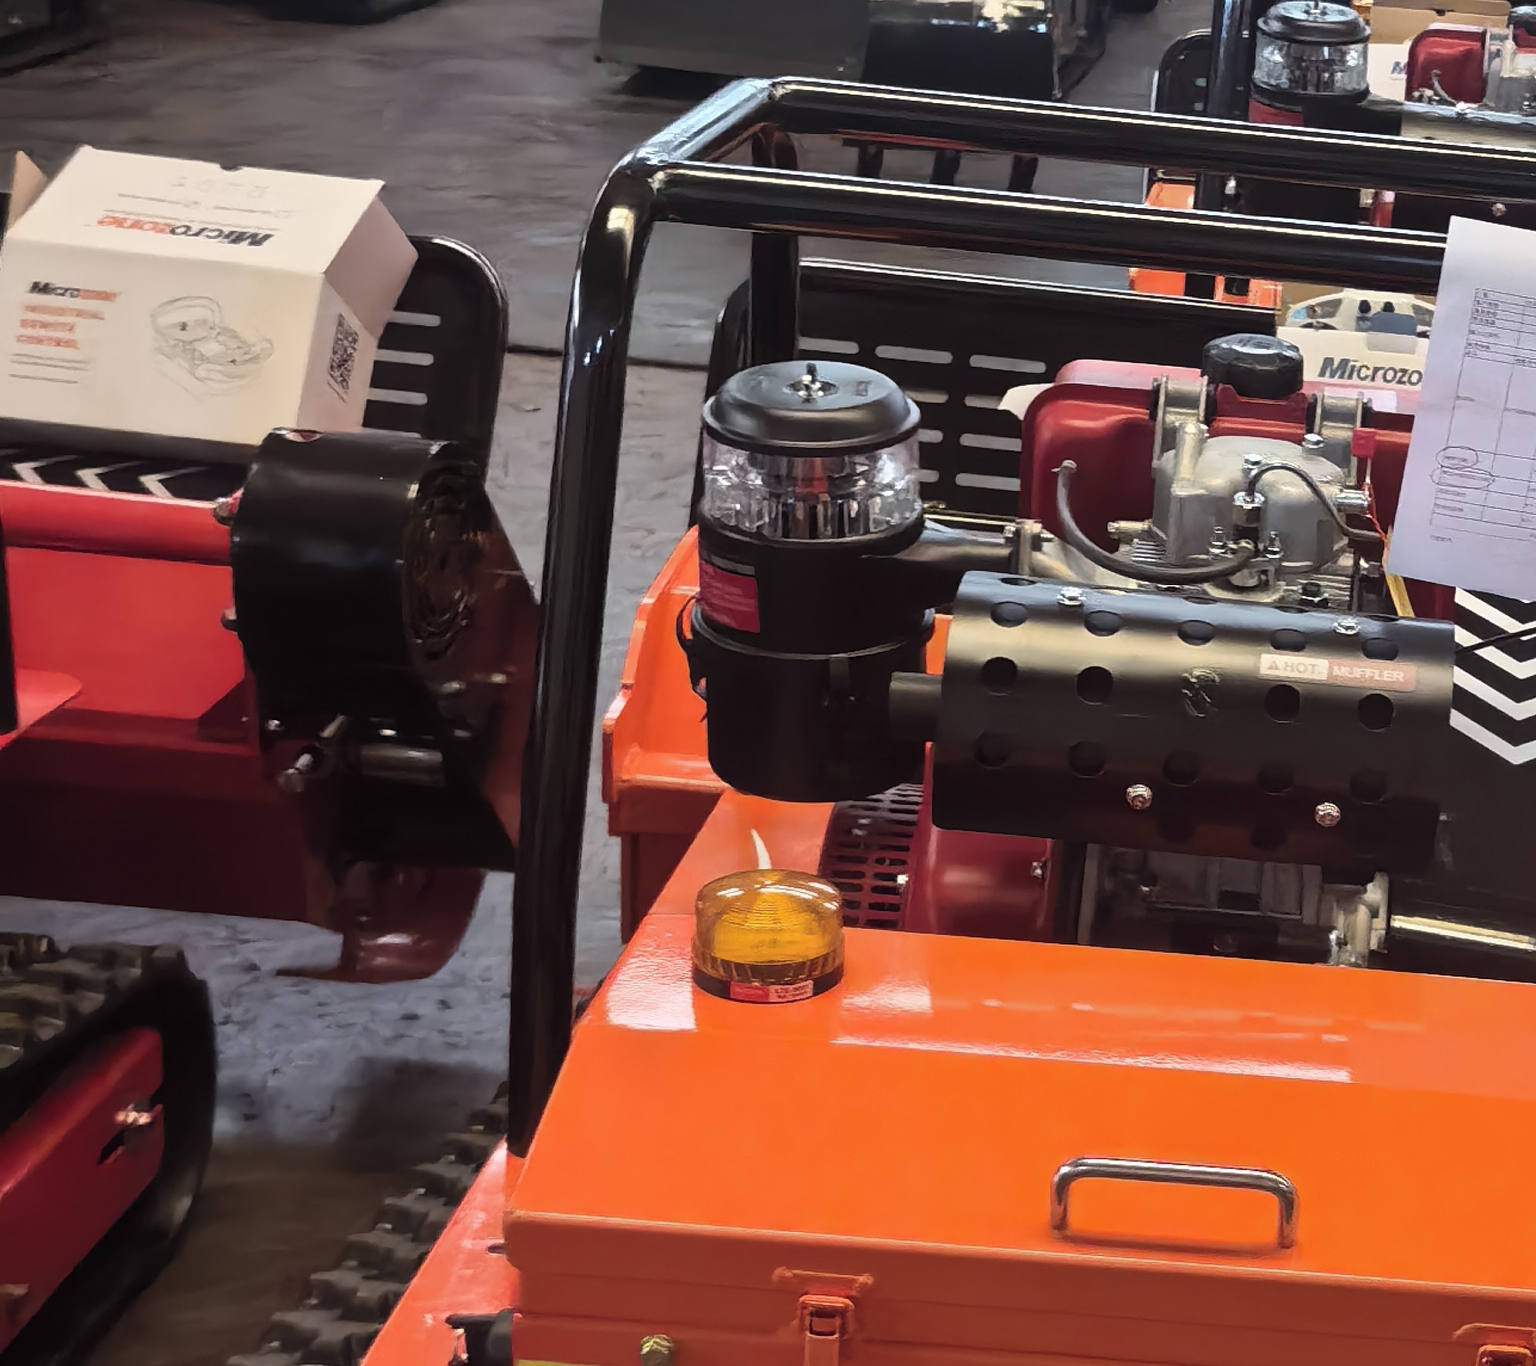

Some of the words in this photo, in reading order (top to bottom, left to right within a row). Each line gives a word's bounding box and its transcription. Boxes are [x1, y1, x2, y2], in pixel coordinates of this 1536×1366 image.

[1318, 356, 1424, 386] Microzo
[1283, 660, 1319, 675] HOT
[1332, 665, 1405, 683] MUFFLER
